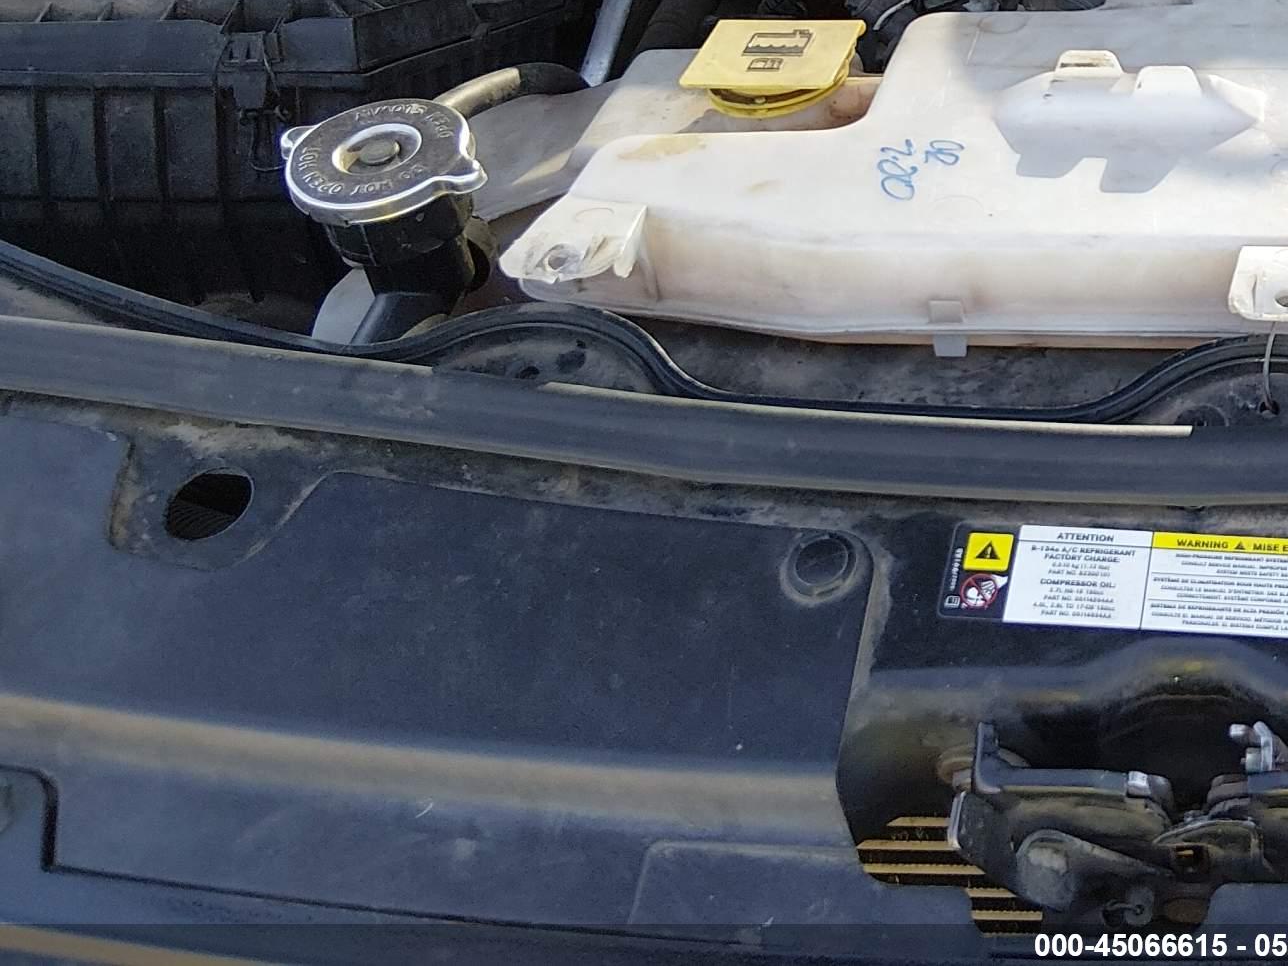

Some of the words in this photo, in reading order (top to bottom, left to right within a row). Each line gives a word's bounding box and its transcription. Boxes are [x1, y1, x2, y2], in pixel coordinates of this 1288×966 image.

[302, 170, 345, 195] OPEN
[1056, 532, 1114, 541] ATTENTION
[1176, 539, 1229, 548] WARNING
[1252, 543, 1279, 551] MISE
[1079, 547, 1136, 555] REFRIGERANT
[1039, 578, 1098, 586] COMPRESSOR
